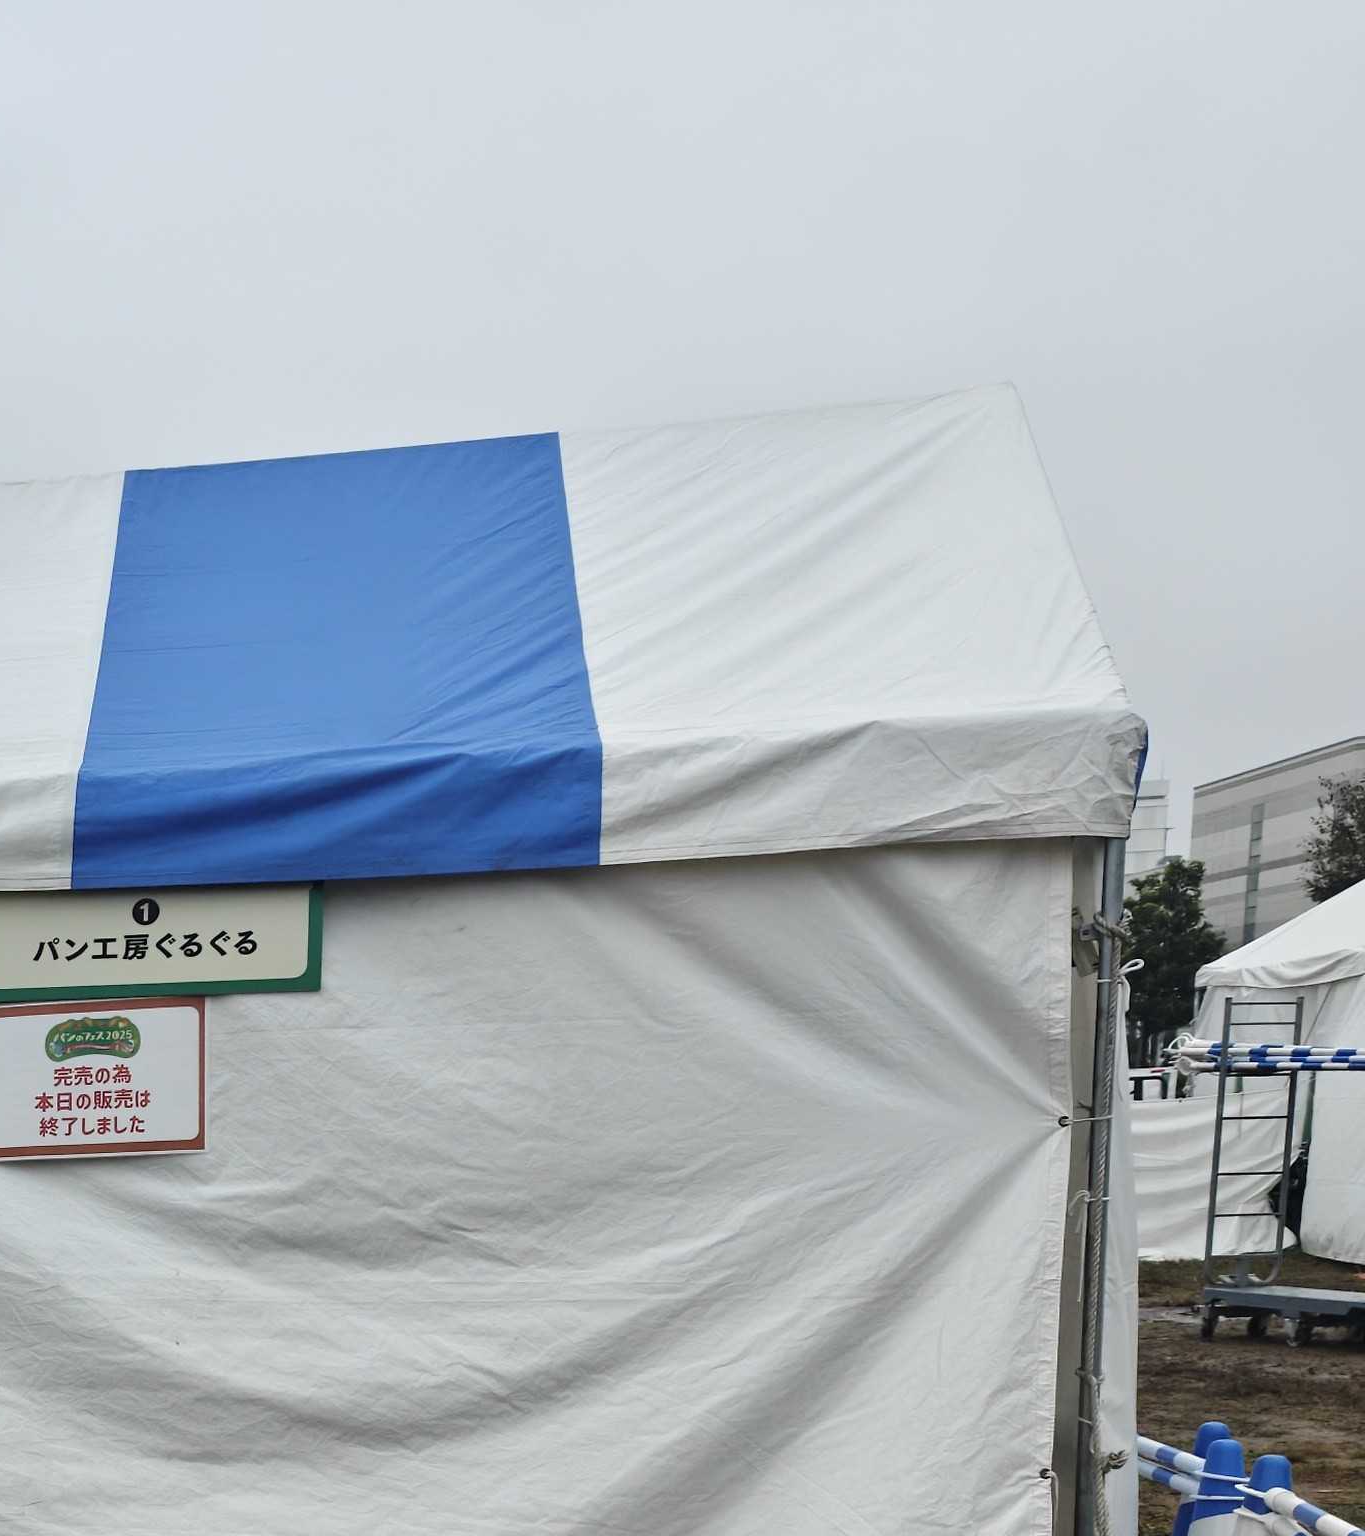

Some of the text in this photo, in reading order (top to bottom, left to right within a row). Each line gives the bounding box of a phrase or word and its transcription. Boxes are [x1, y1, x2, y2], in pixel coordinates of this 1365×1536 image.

[33, 931, 258, 961] パン工房ぐるぐる
[54, 1064, 132, 1086] 完売の為
[35, 1089, 151, 1112] 本日の販売は
[39, 1115, 145, 1137] 終了しました
